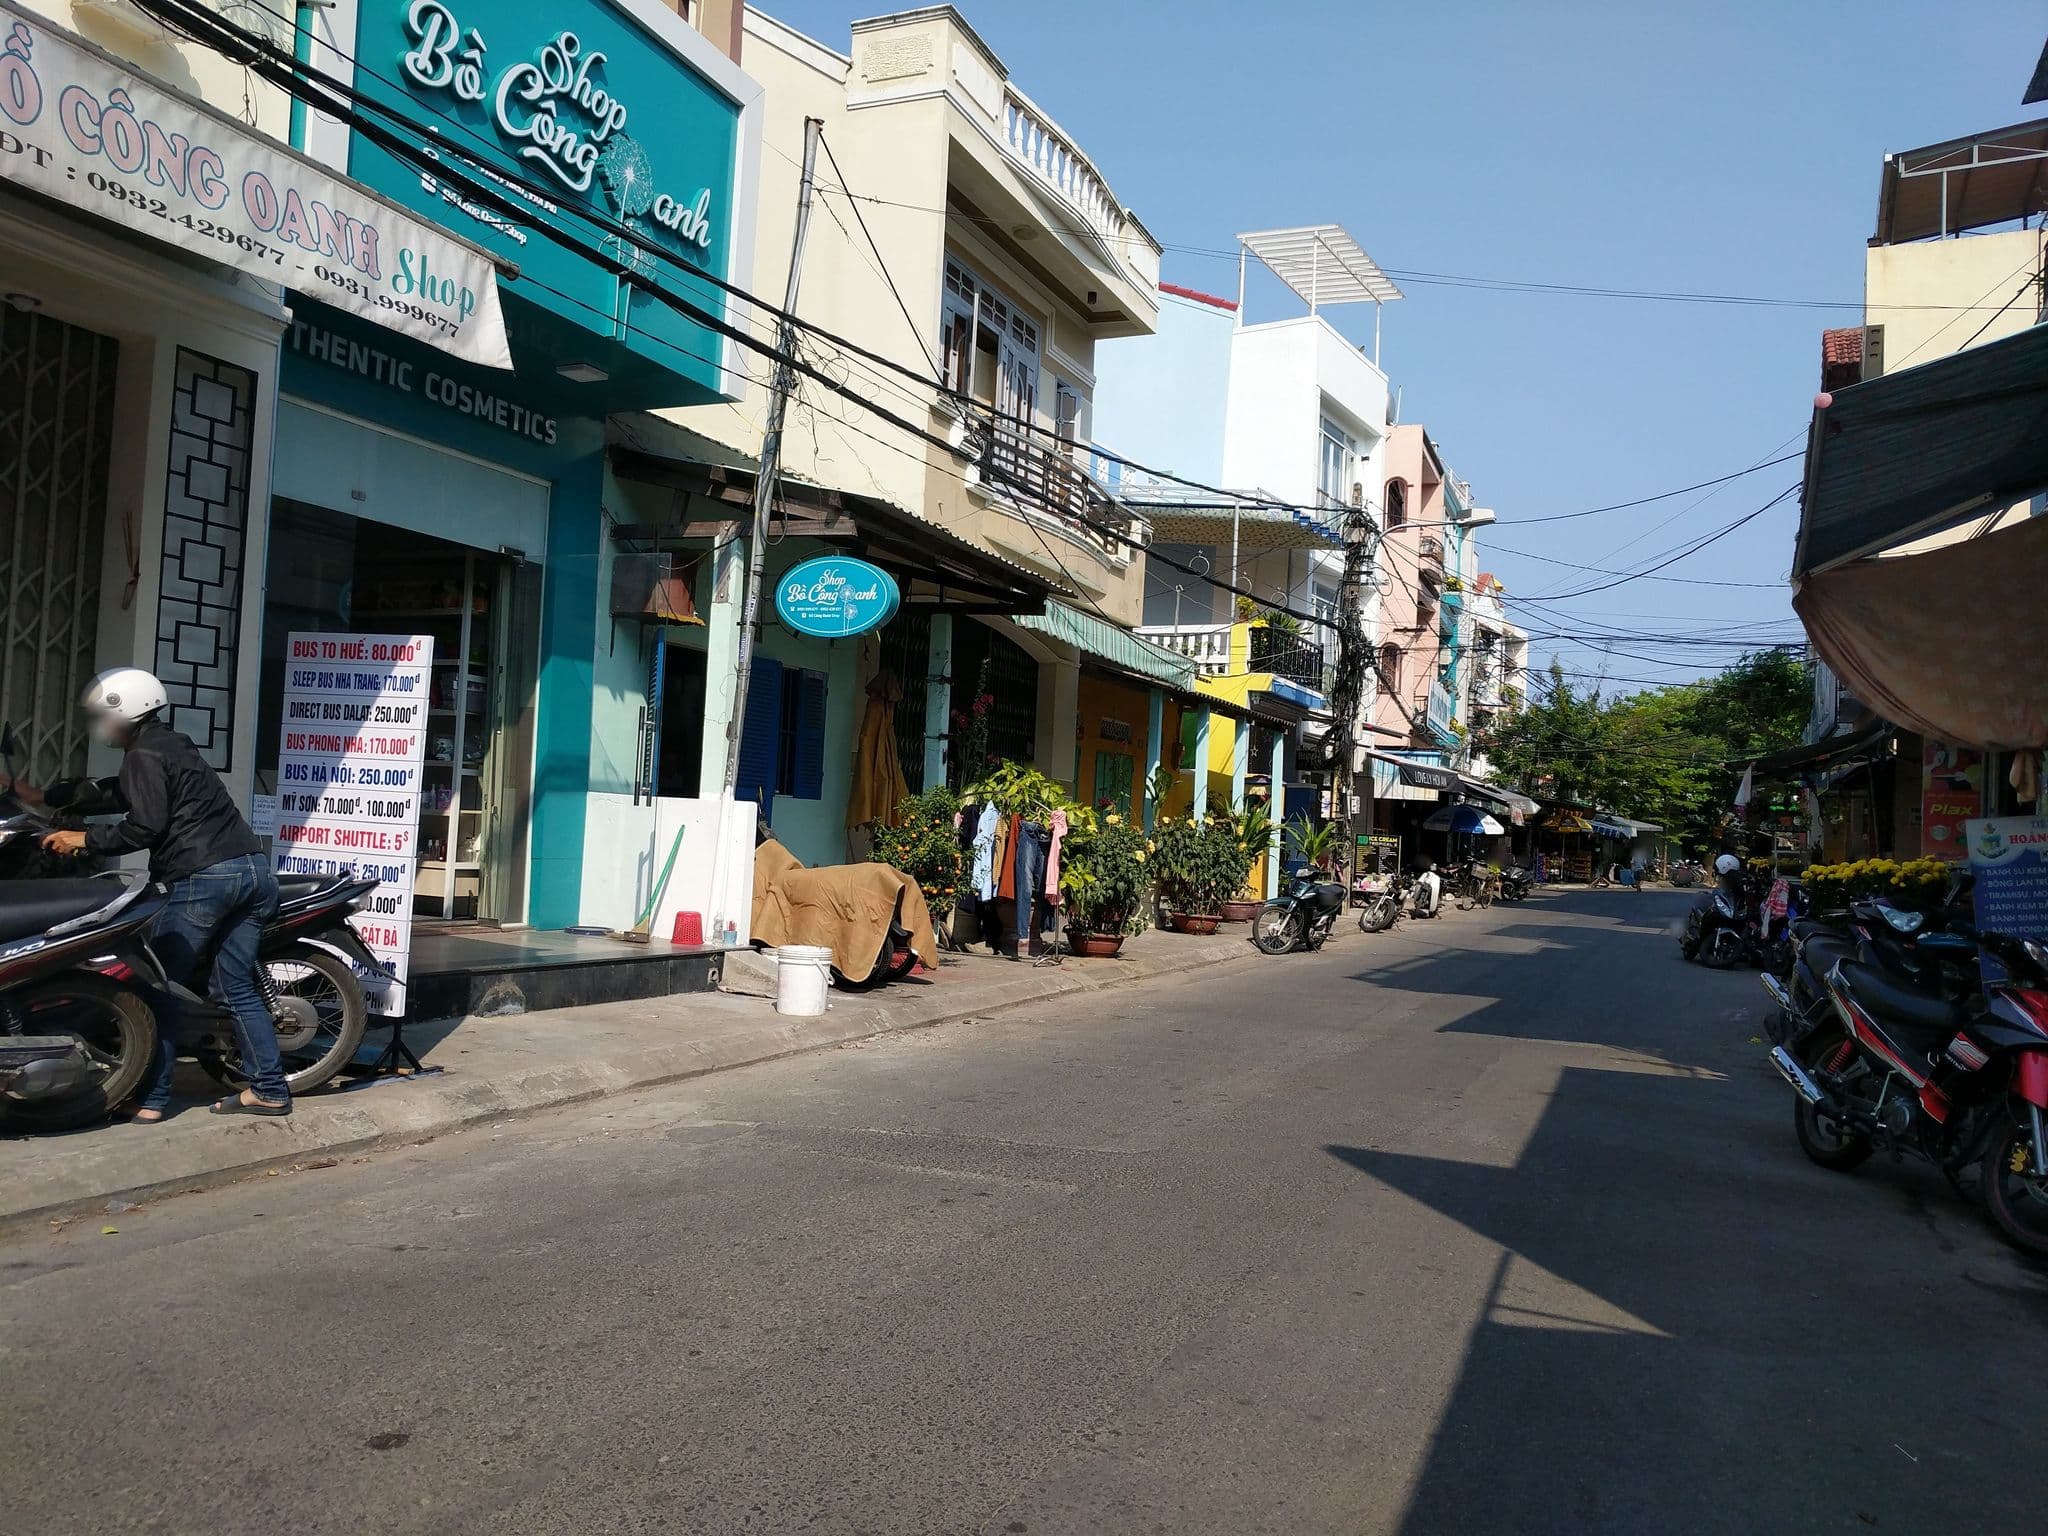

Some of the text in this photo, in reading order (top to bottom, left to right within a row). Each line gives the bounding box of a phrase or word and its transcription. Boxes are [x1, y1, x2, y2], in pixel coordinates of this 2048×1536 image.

[541, 31, 627, 141] Shop
[496, 63, 598, 192] Công
[59, 84, 229, 210] CÔNG
[242, 170, 382, 281] OANH
[392, 248, 478, 323] Shop
[87, 172, 285, 264] 0932.429677
[314, 265, 460, 338] 0931.999677
[424, 371, 558, 446] COSMETICS
[819, 568, 846, 590] Shop
[808, 583, 839, 606] Công
[293, 640, 318, 658] BUS
[321, 641, 336, 659] TO
[292, 670, 317, 687] SLEEP
[317, 671, 334, 689] BUS
[334, 672, 352, 689] NHA
[353, 673, 381, 691] TRANG:
[289, 701, 321, 719] DIRECT
[322, 702, 342, 720] BUS
[343, 703, 372, 722] DALAT:
[286, 733, 306, 750] BUS
[307, 734, 341, 752] PHONG
[343, 735, 368, 754] NHA:
[284, 763, 308, 781] BUS
[311, 762, 327, 782] HÀ
[1930, 803, 1973, 815] Plax
[279, 824, 331, 845] AIRPORT
[334, 829, 391, 850] SHUTTLE:
[277, 854, 323, 875] MOTOBIKE
[325, 860, 337, 875] TO
[383, 926, 398, 947] BÀ
